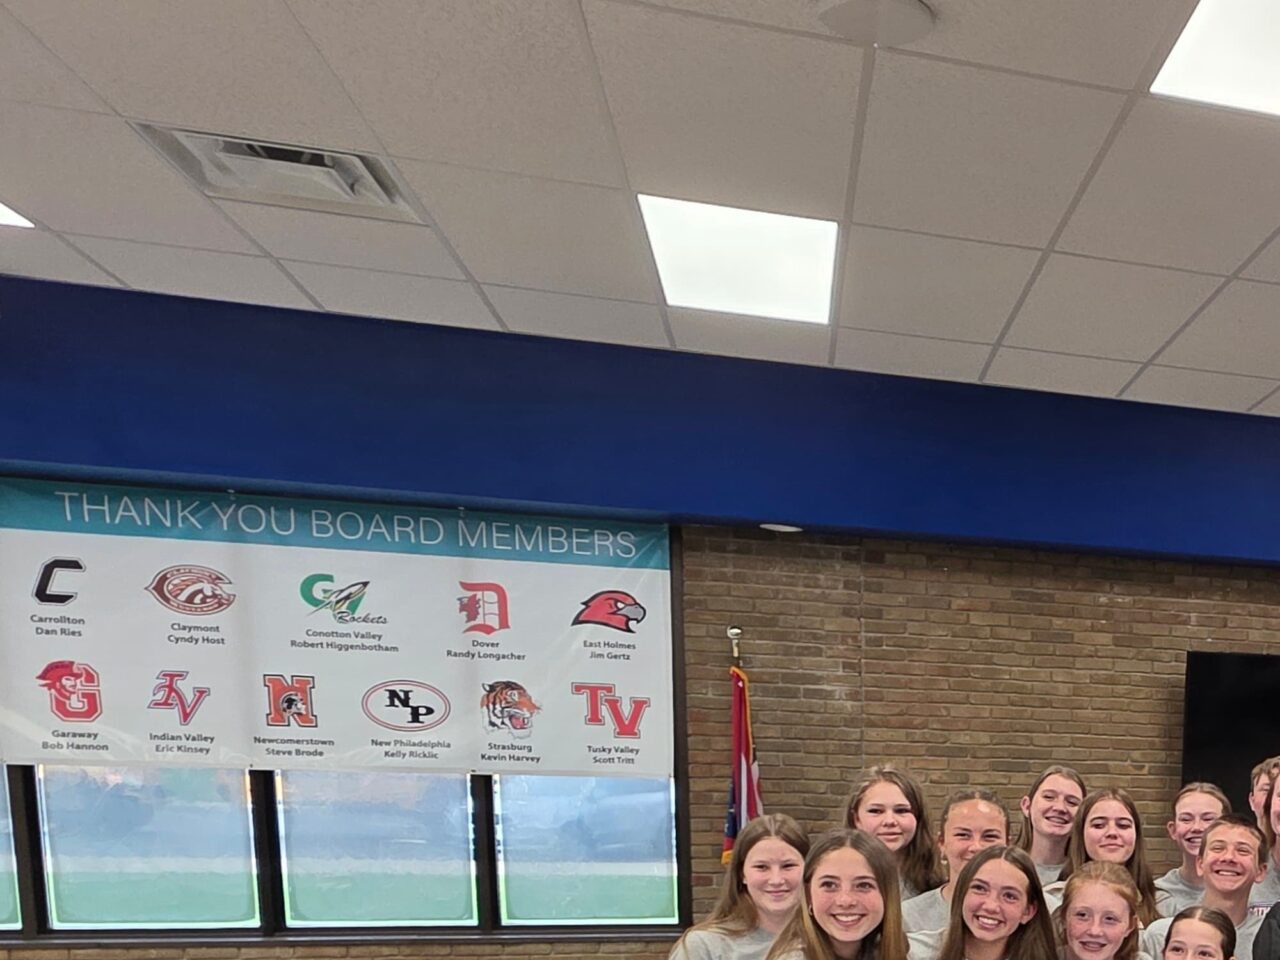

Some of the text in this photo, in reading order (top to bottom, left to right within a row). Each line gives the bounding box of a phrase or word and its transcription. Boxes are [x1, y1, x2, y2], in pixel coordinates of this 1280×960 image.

[55, 491, 636, 558] THANK YOU BOARD MEMBERS
[30, 614, 85, 625] Carrollton
[336, 611, 388, 624] Rockets
[36, 627, 82, 637] Dan Ries
[170, 622, 220, 633] Claymont
[167, 634, 225, 645] Cyndy Host
[305, 629, 383, 641] Conotton Valley
[290, 640, 400, 652] Robert Higgenbotham
[472, 640, 500, 648] Dover
[583, 640, 636, 650] East Holmes
[446, 650, 526, 661] Randy Longacher
[589, 652, 631, 661] Jim Gertz
[384, 689, 435, 724] NP
[571, 682, 651, 739] TV
[51, 730, 98, 741] Garaway
[149, 733, 215, 743] Indian Valley
[253, 736, 335, 746] Newcomerstown
[42, 742, 109, 752] Bob Hannon
[155, 744, 210, 754] Eric Kinsey
[371, 739, 451, 749] New Philadelphia
[488, 742, 533, 753] Strasburg
[265, 747, 324, 757] Steve Brode
[384, 751, 407, 759] Kelly
[587, 745, 640, 756] Tusky Valley
[480, 753, 541, 764] Kevin Harvey
[593, 756, 635, 765] Scott Tritt
